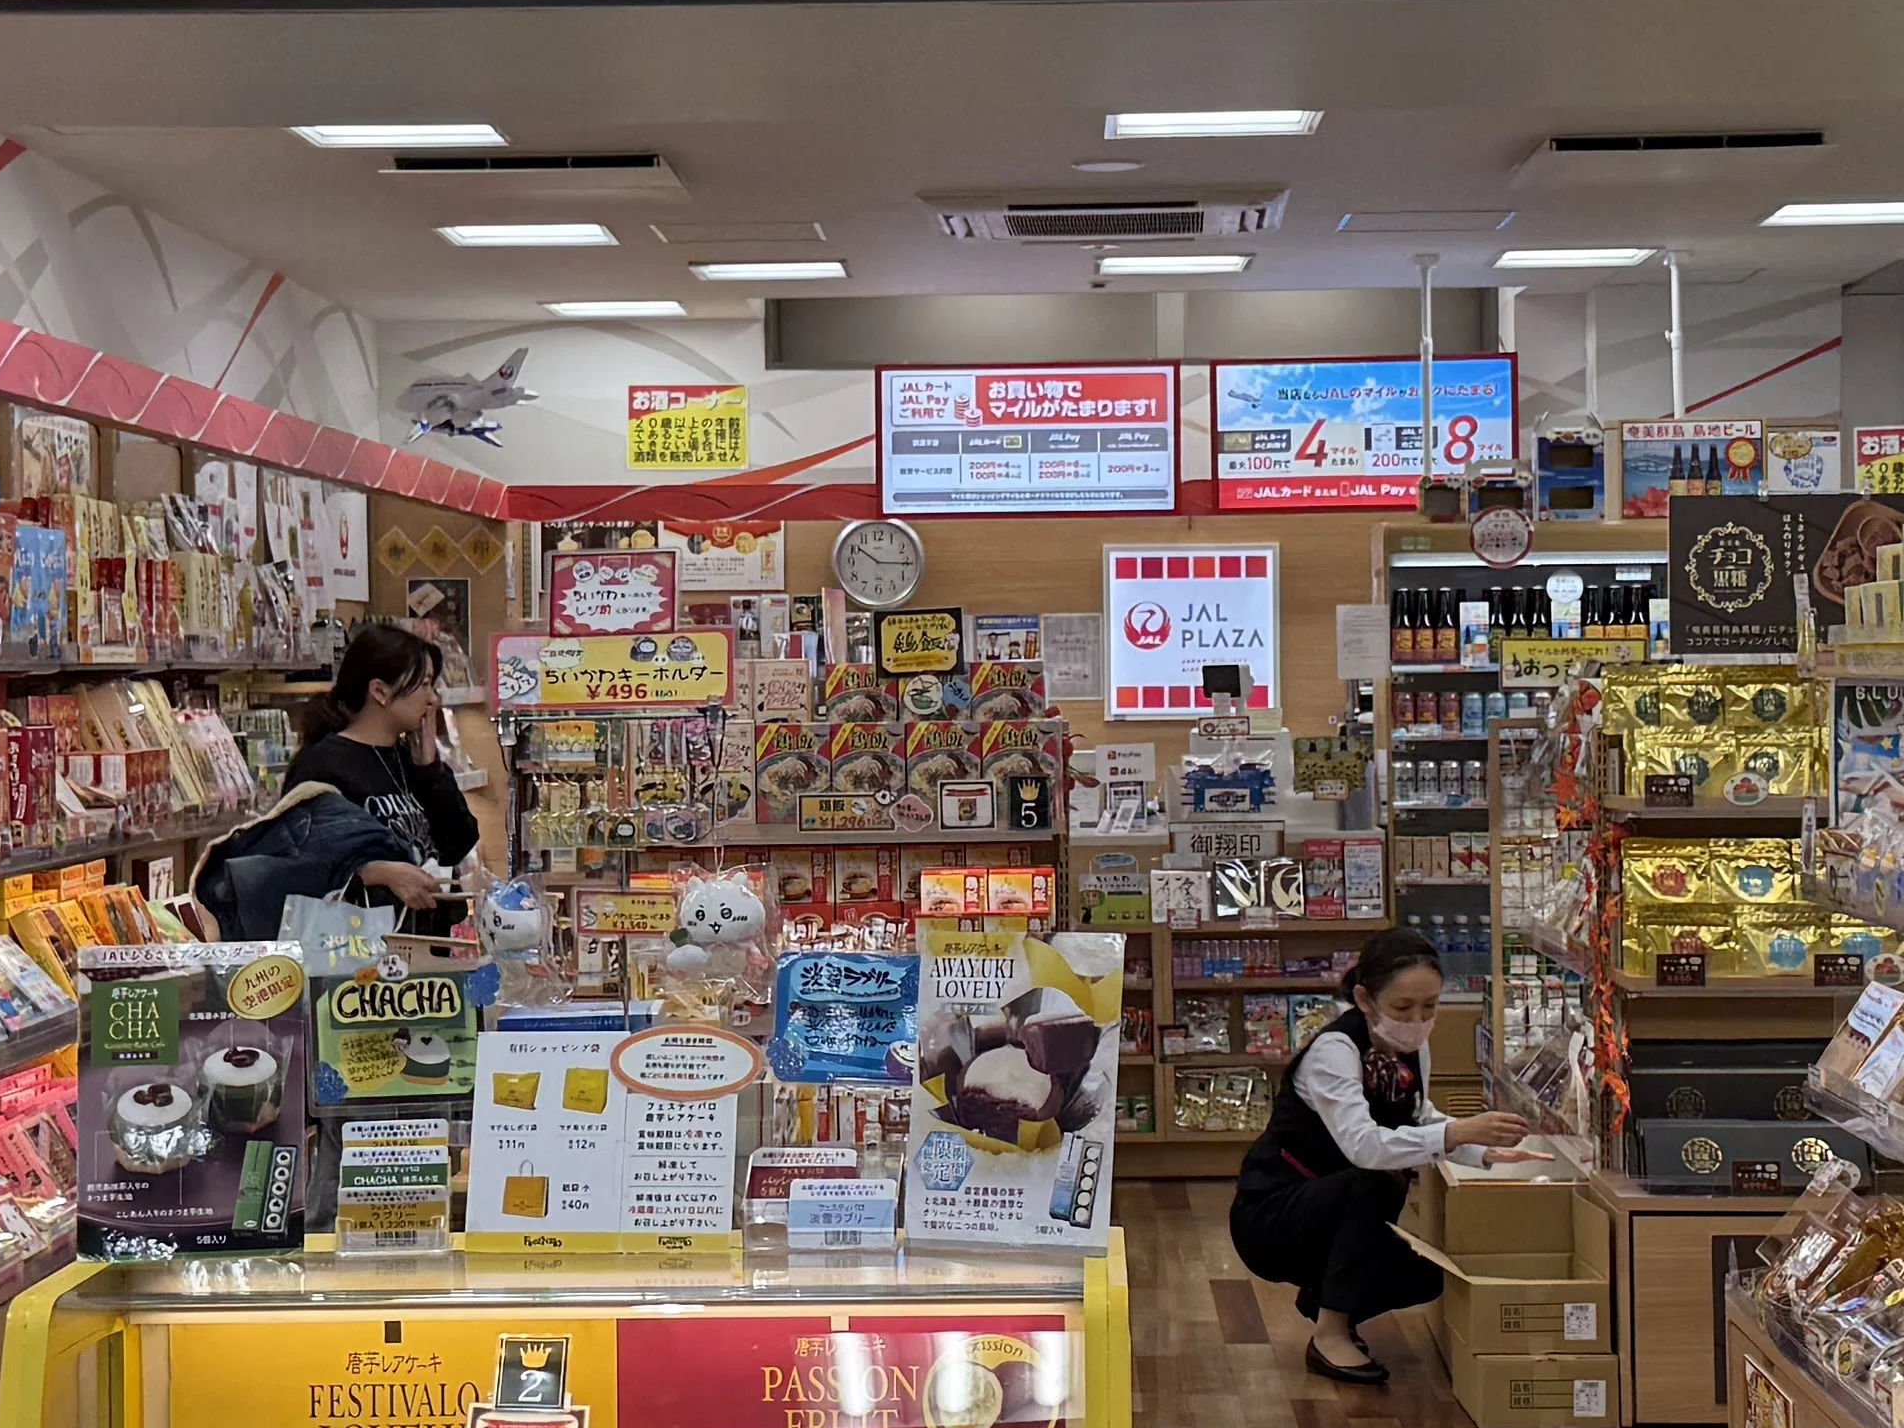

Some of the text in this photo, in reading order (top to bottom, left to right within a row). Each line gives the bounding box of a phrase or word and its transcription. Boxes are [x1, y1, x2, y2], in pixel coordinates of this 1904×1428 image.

[632, 389, 746, 412] お酒コーナー
[1294, 418, 1328, 468] 4
[1444, 415, 1478, 465] 8
[1181, 603, 1227, 622] JAL
[1181, 627, 1264, 648] PLAZA
[1021, 802, 1038, 829] 5
[930, 958, 1014, 980] AWAYUKI
[335, 981, 459, 1016] CHACHA
[936, 979, 1006, 1000] LOVELY
[109, 1002, 160, 1020] CHA
[109, 1021, 161, 1040] CHA
[517, 1369, 544, 1404] 2
[761, 1365, 920, 1403] PASSON
[308, 1381, 481, 1419] FESTIVALO
